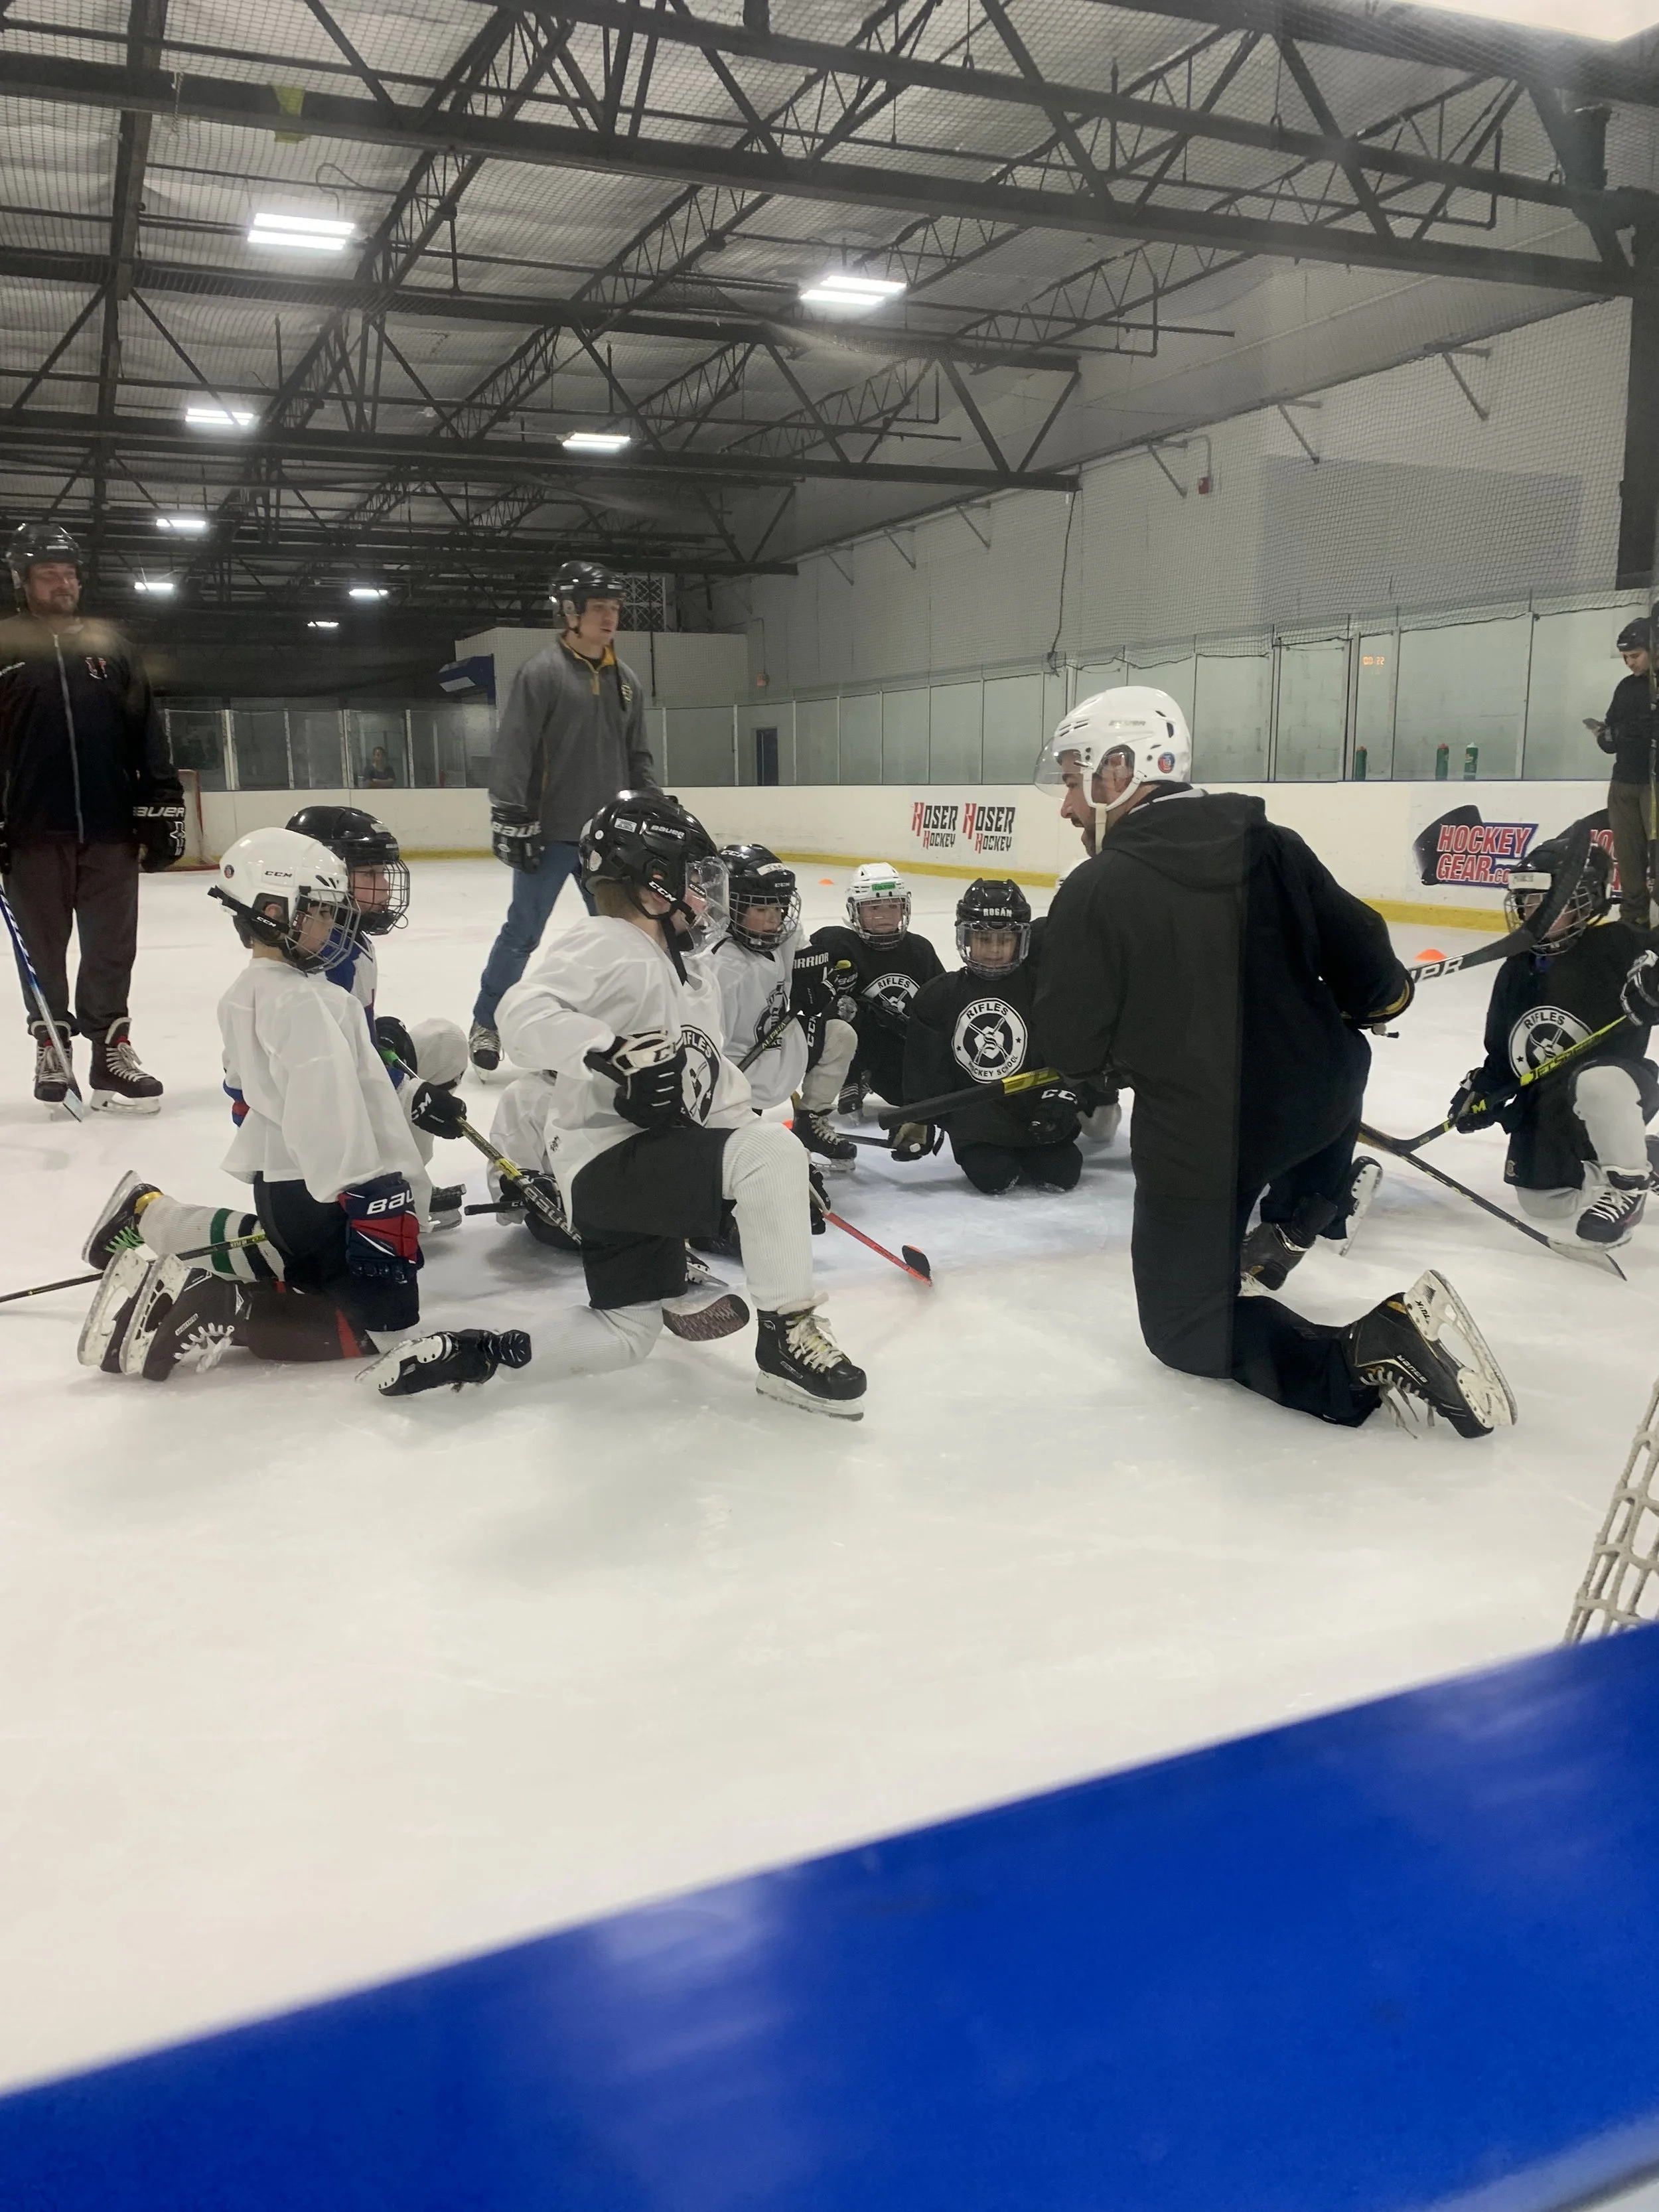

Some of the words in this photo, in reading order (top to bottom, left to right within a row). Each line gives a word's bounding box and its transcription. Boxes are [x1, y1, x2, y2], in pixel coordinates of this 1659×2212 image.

[912, 802, 958, 836] HOSER
[963, 803, 1016, 840] HOSER
[651, 824, 685, 840] BAUER
[922, 830, 956, 849] HOCKEY
[1437, 824, 1533, 858] HOCKEY
[975, 832, 1012, 854] HOCKEY
[721, 849, 750, 859] CCM
[648, 881, 677, 901] CCM
[689, 883, 705, 895] CCM
[256, 916, 277, 927] CCM
[794, 952, 829, 969] RRIOR
[877, 978, 910, 989] RIFLES
[966, 1003, 1009, 1019] RIFLES
[1524, 1011, 1565, 1029] RIFLES
[682, 1031, 713, 1058] IFLES
[1041, 1089, 1078, 1104] CC
[411, 1092, 433, 1121] CM
[1396, 1354, 1428, 1384] BAUER
